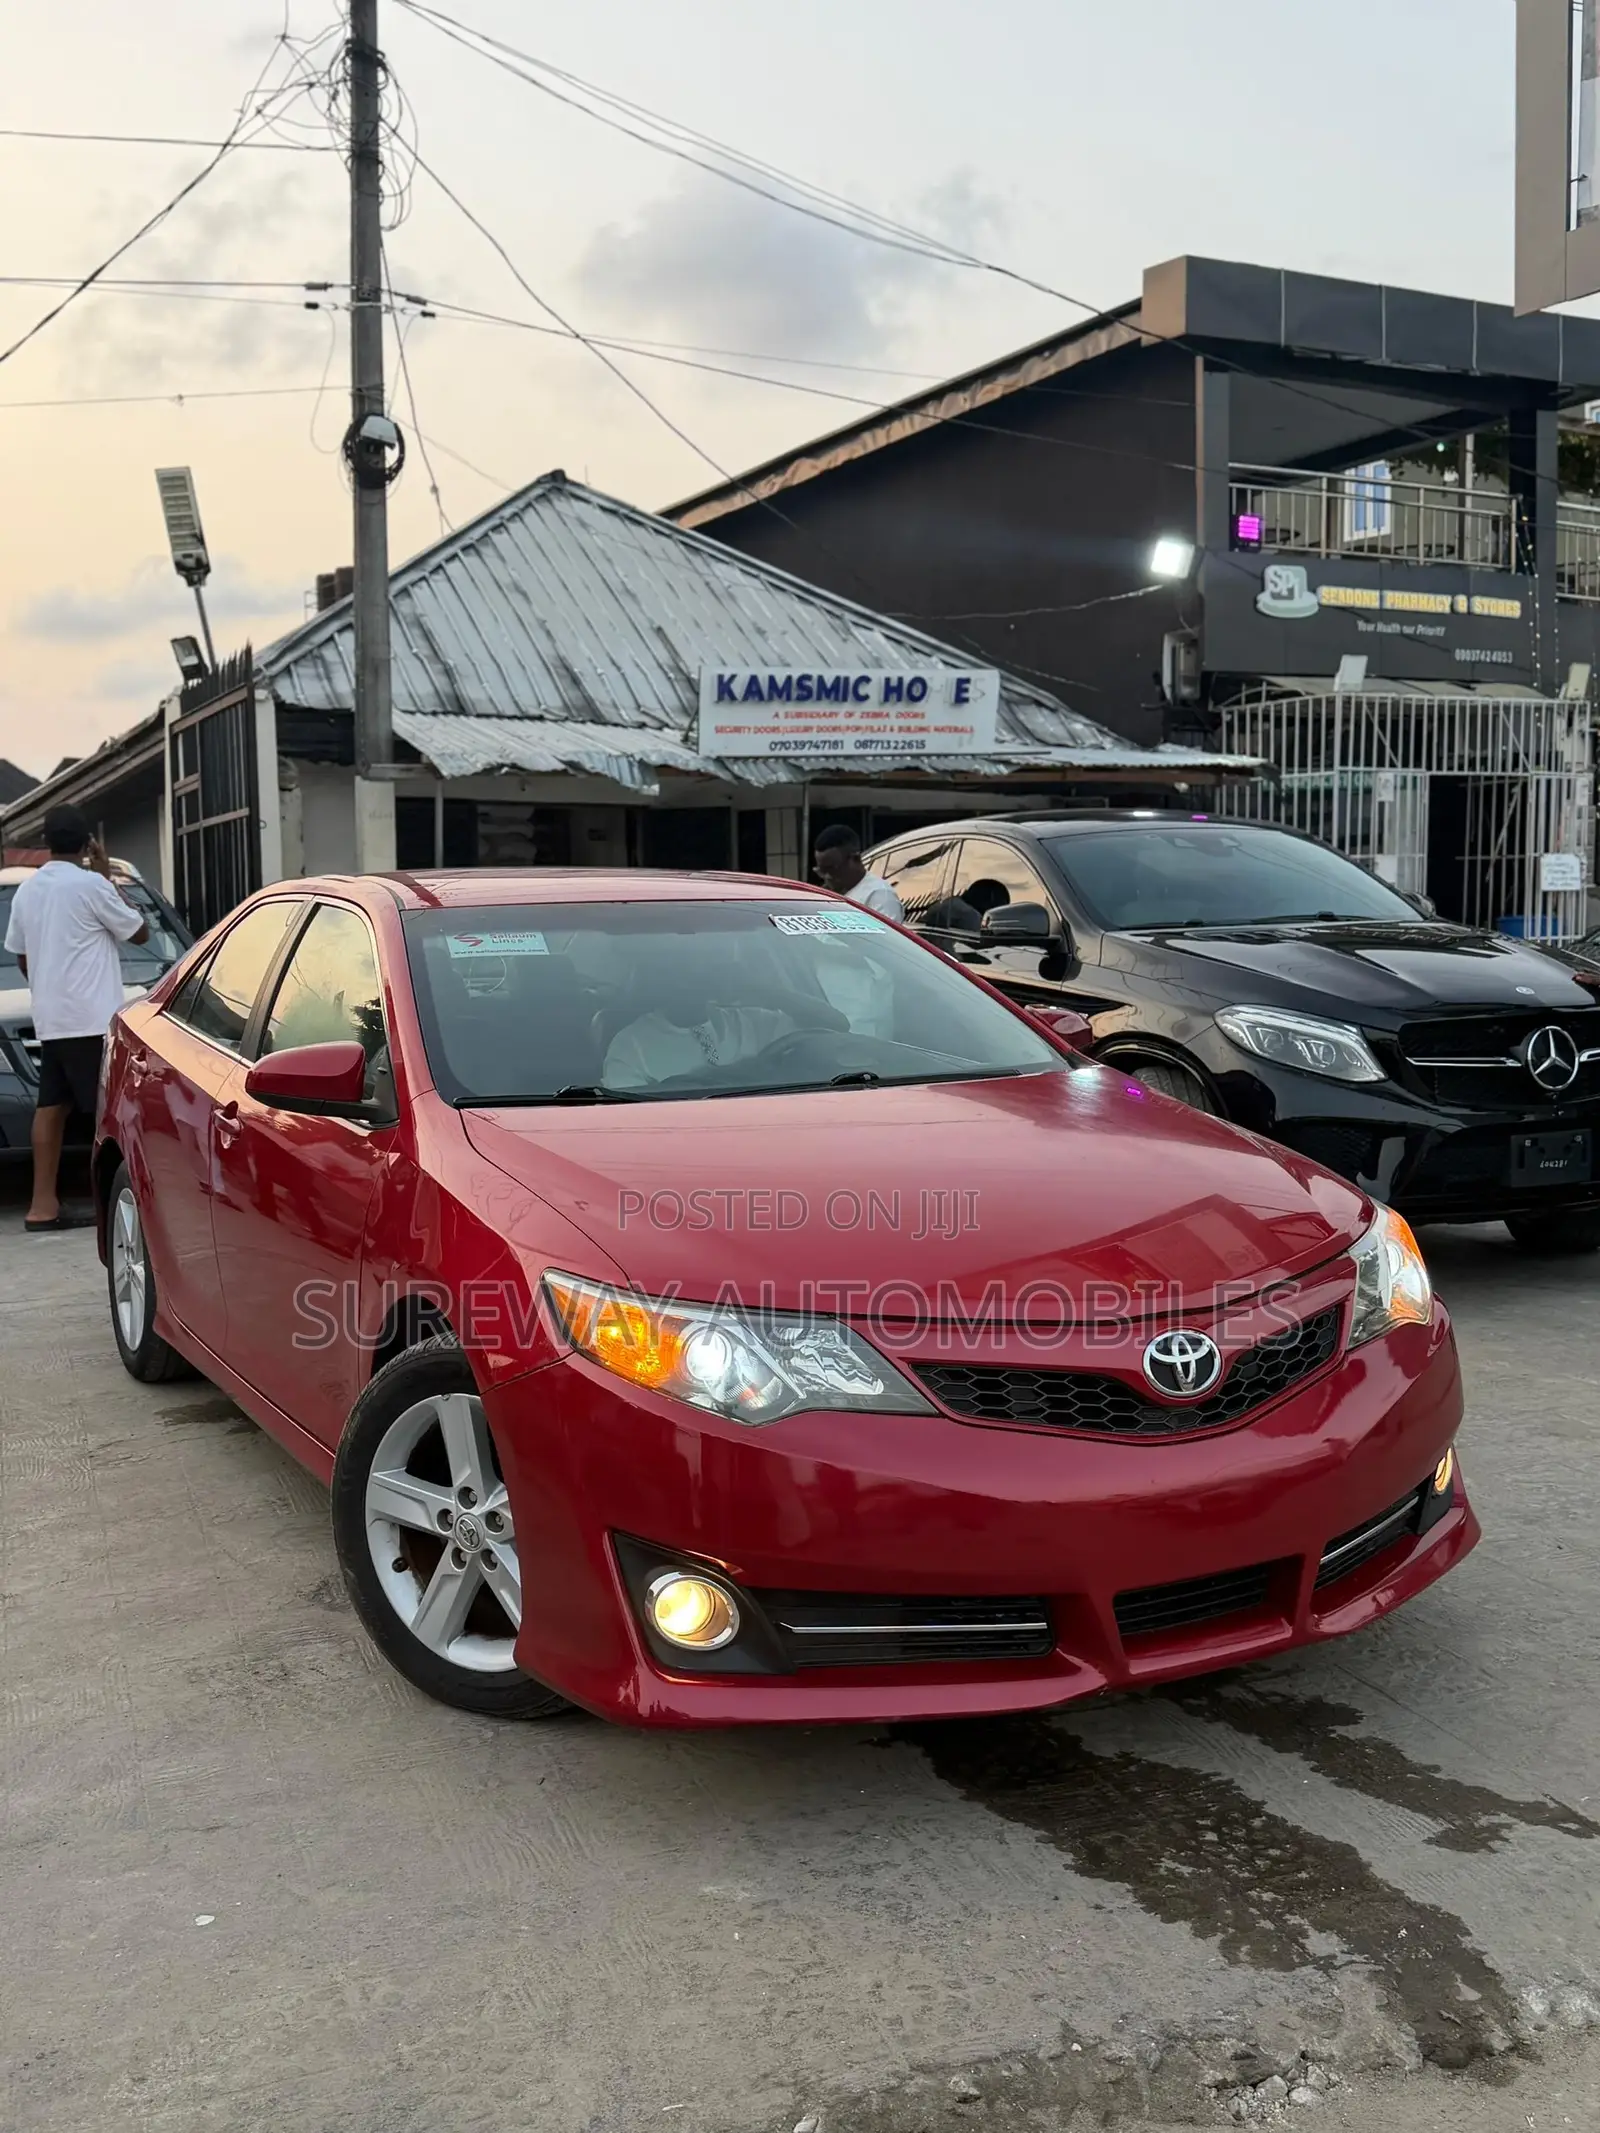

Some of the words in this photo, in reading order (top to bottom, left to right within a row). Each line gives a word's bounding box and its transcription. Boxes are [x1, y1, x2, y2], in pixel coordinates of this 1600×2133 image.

[1384, 590, 1452, 613] PHARMACY
[1472, 596, 1521, 618] STORES
[716, 673, 872, 703] KAMSMIC
[772, 711, 780, 719] A
[784, 711, 839, 719] SUBSIDIARY
[844, 711, 855, 719] OF
[860, 711, 889, 719] ZEBRA
[714, 725, 751, 734] SECURITY
[898, 725, 931, 734] BUILDING
[934, 725, 974, 734] MATERIALS
[769, 740, 844, 751] 07039747181
